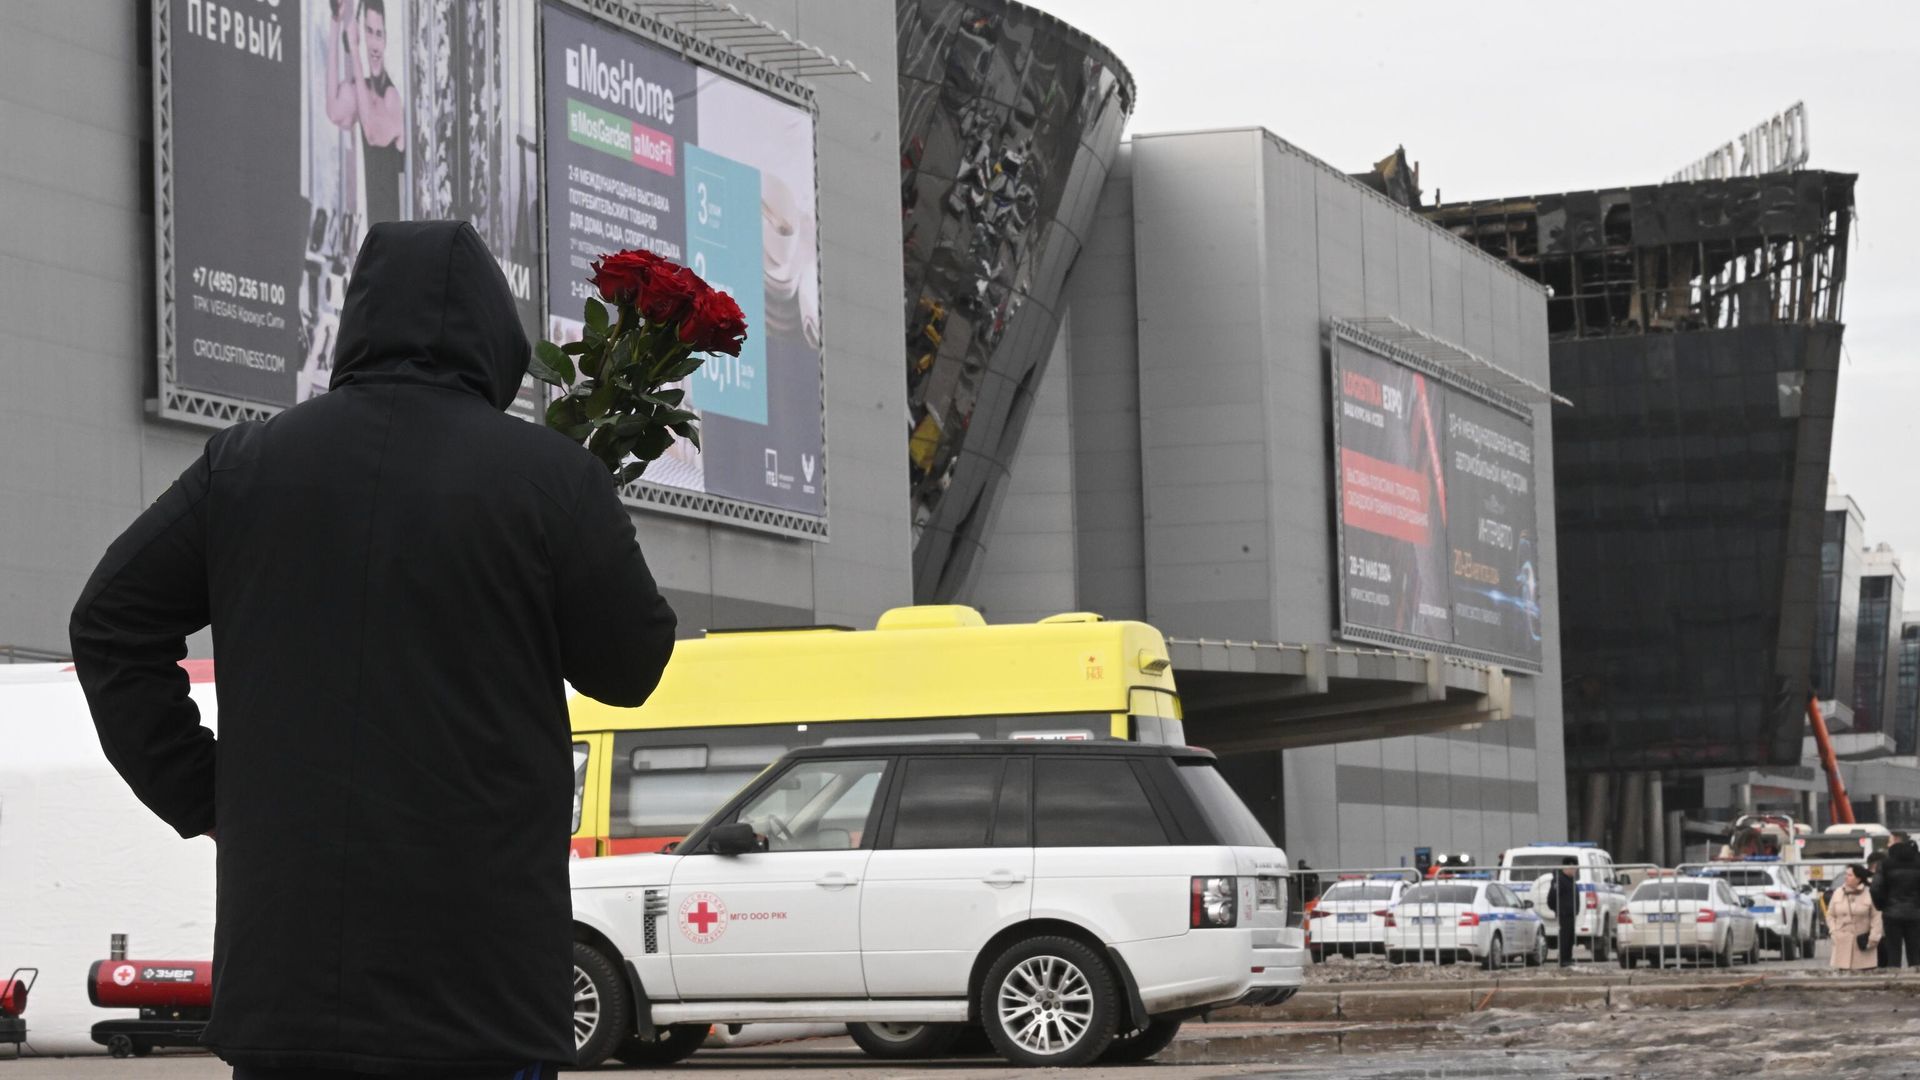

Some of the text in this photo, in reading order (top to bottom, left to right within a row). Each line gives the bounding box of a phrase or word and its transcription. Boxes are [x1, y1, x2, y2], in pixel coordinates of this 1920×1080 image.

[187, 0, 282, 62] ПЕРВЫЙ
[581, 43, 674, 125] MosHome
[577, 110, 631, 151] MosGarden
[641, 133, 673, 167] MosFit
[580, 167, 637, 201] МЕЖДУНАРОДНАЯ
[637, 187, 670, 213] ВЫСТАВКА
[697, 182, 709, 225] 3
[569, 211, 584, 230] ДЛЯ
[629, 206, 657, 231] ТОВАРОВ
[193, 265, 286, 306] +7 (495) 236 11 00
[210, 299, 237, 319] VEGAS
[239, 306, 266, 328] Крокус
[193, 338, 286, 373] CROCUSFITNESS.COM
[730, 911, 788, 921] МГО ООО РКК
[155, 969, 194, 979] ЗУБР
